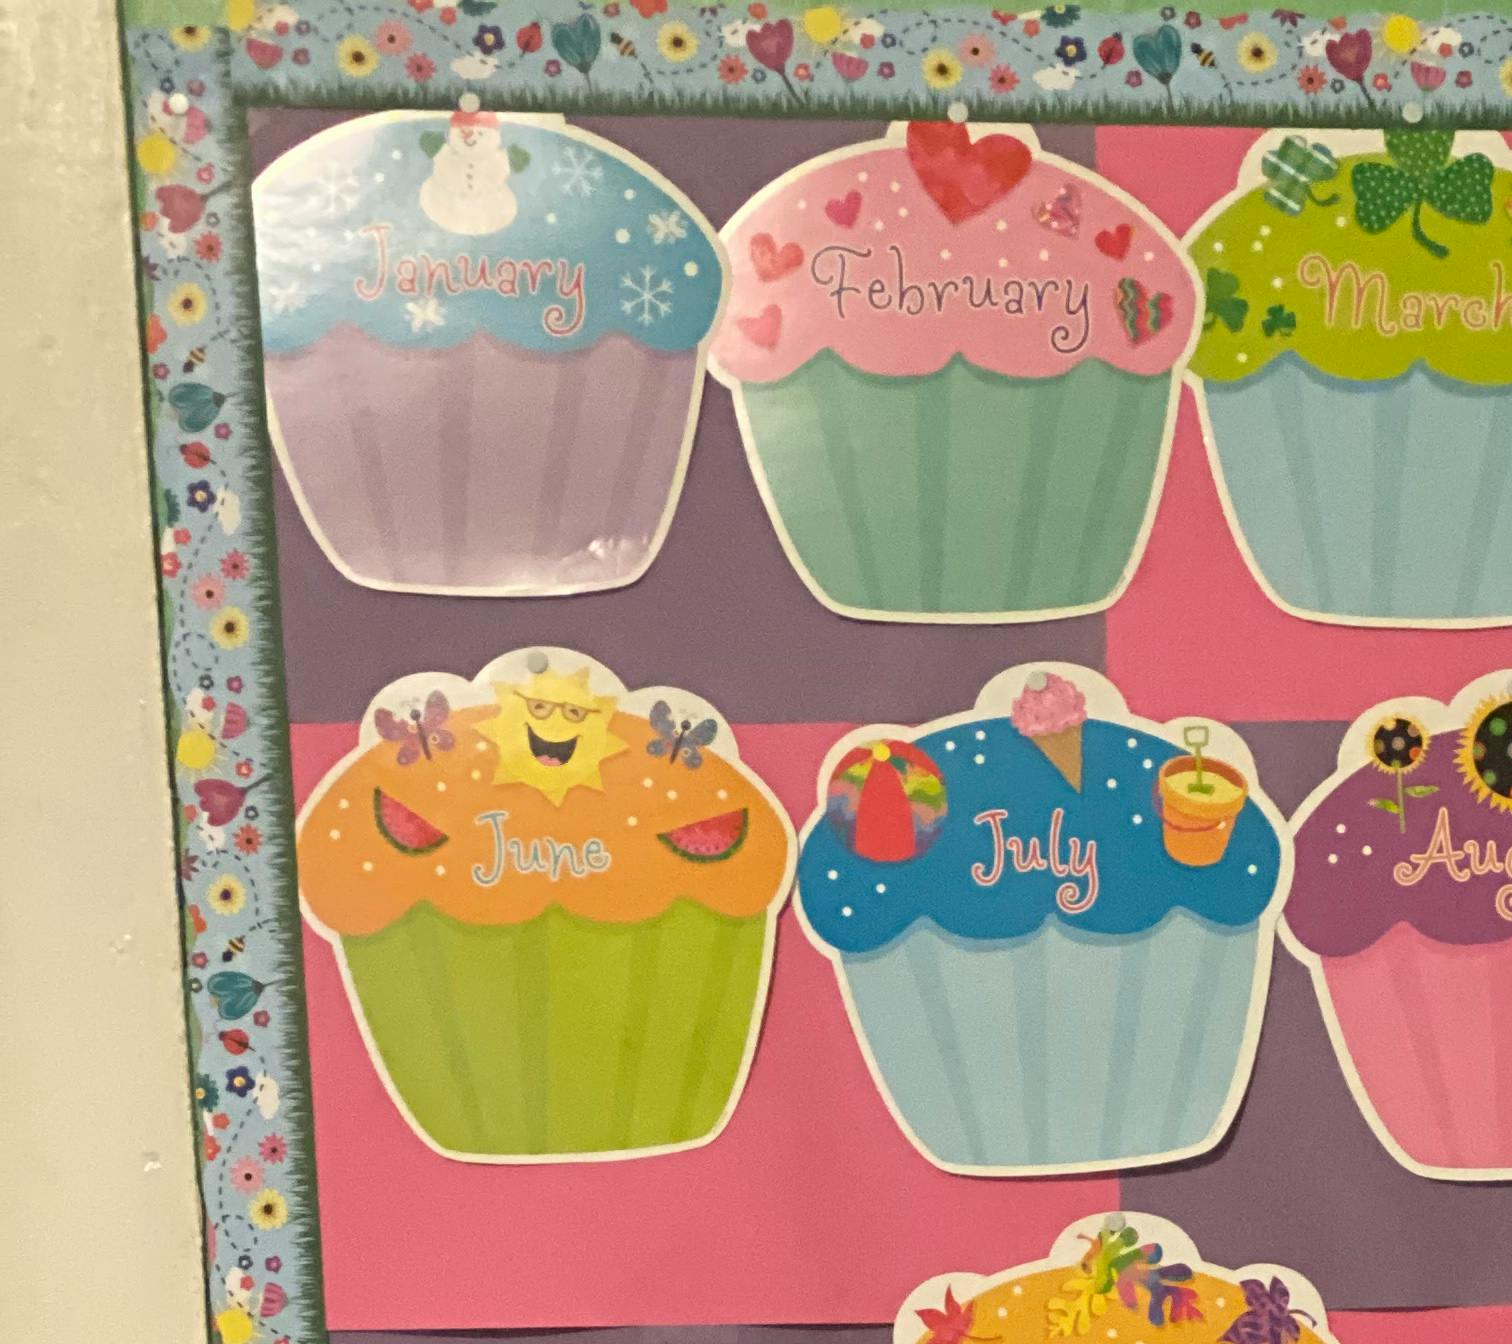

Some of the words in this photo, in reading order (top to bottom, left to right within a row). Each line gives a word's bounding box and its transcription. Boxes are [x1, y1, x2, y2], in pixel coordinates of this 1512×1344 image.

[354, 222, 586, 337] January
[810, 245, 1089, 354] February
[472, 810, 611, 886] June
[971, 808, 1099, 914] July
